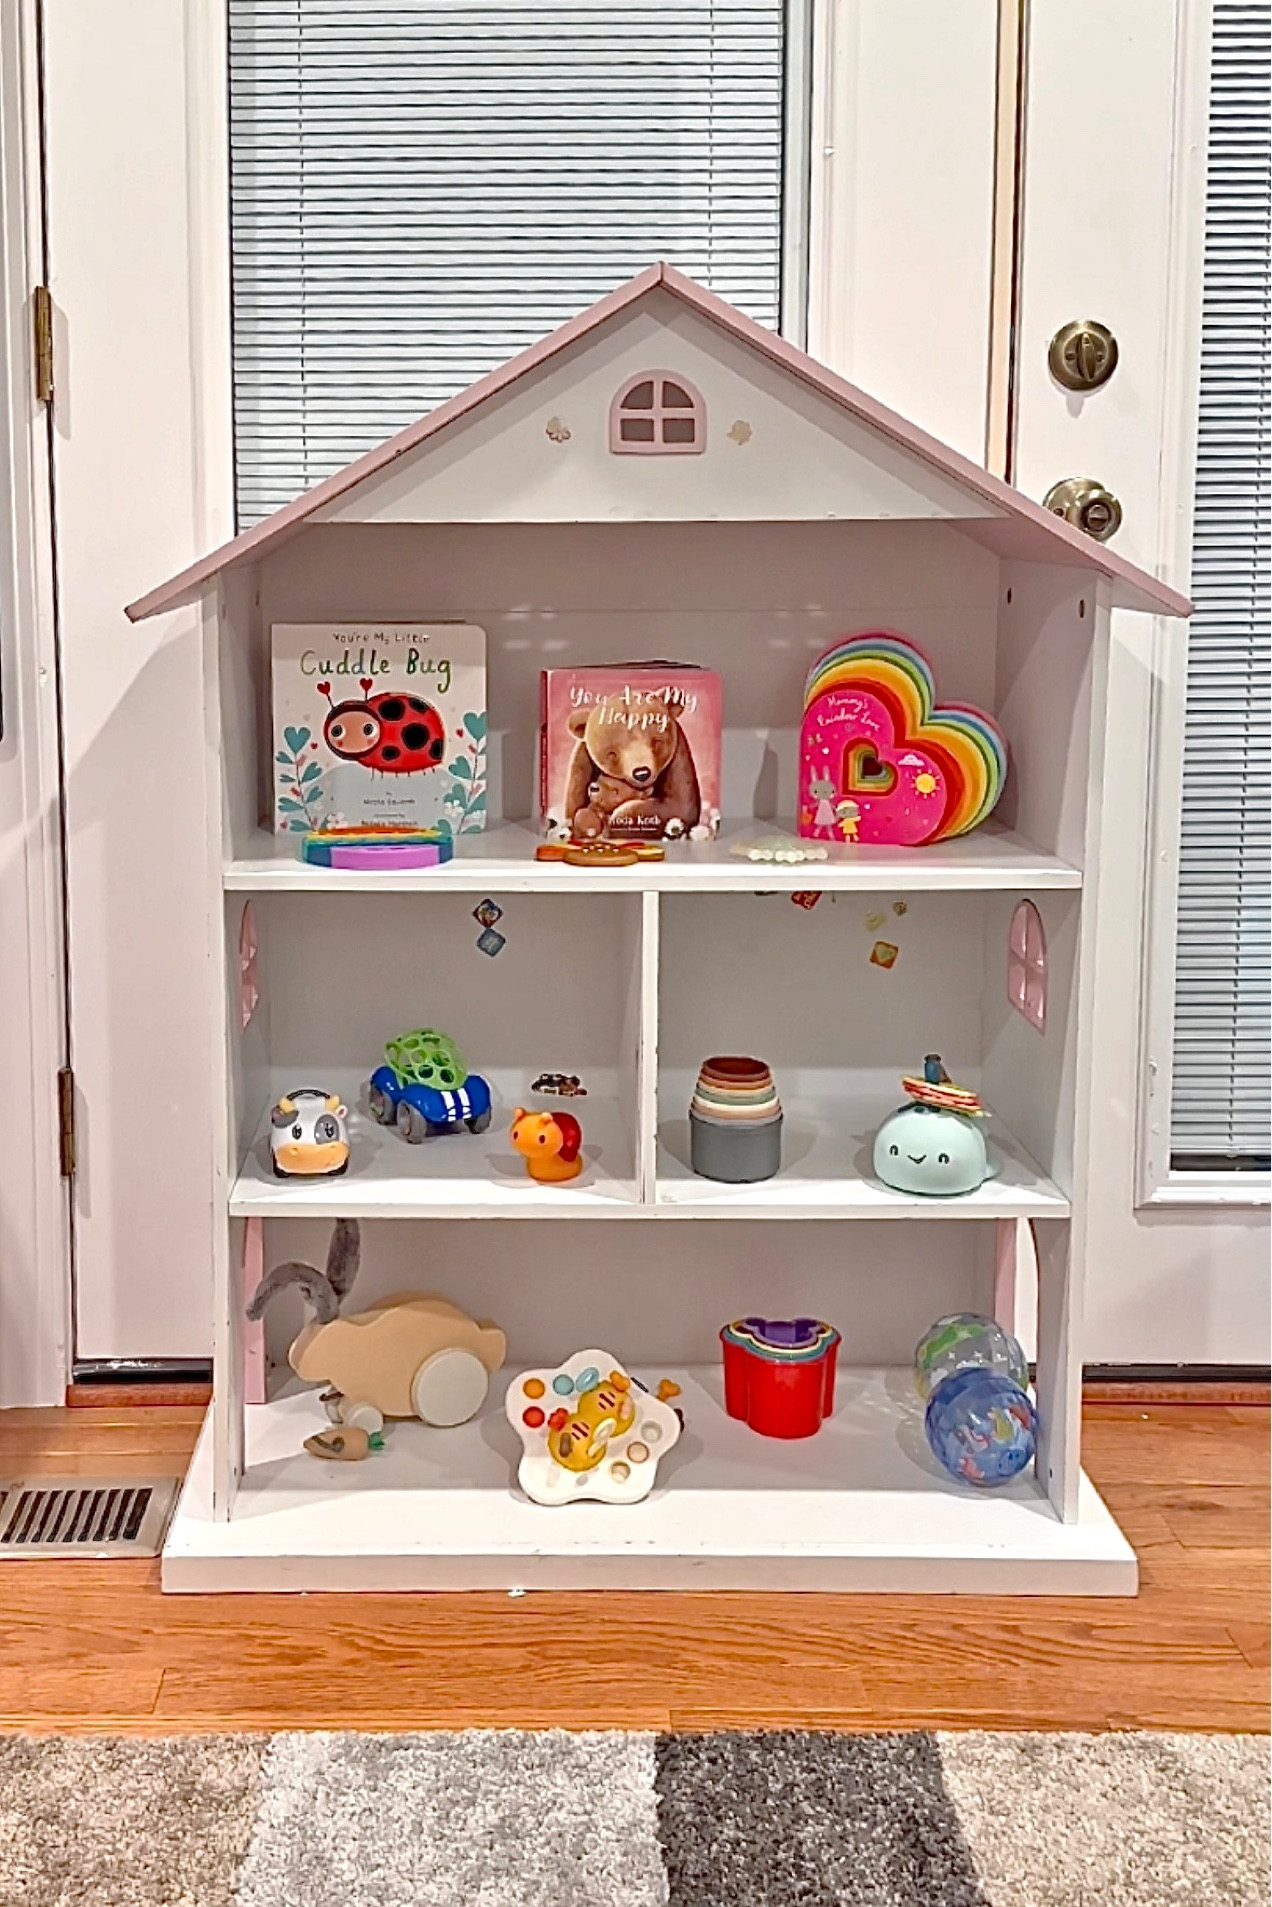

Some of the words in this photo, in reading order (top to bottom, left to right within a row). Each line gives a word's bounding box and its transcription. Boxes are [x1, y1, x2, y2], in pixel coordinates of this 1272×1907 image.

[301, 648, 391, 675] Cuddle
[406, 647, 451, 693] Bug
[570, 686, 607, 707] You
[619, 685, 659, 706] Are
[664, 686, 698, 713] My
[599, 706, 669, 732] Happy
